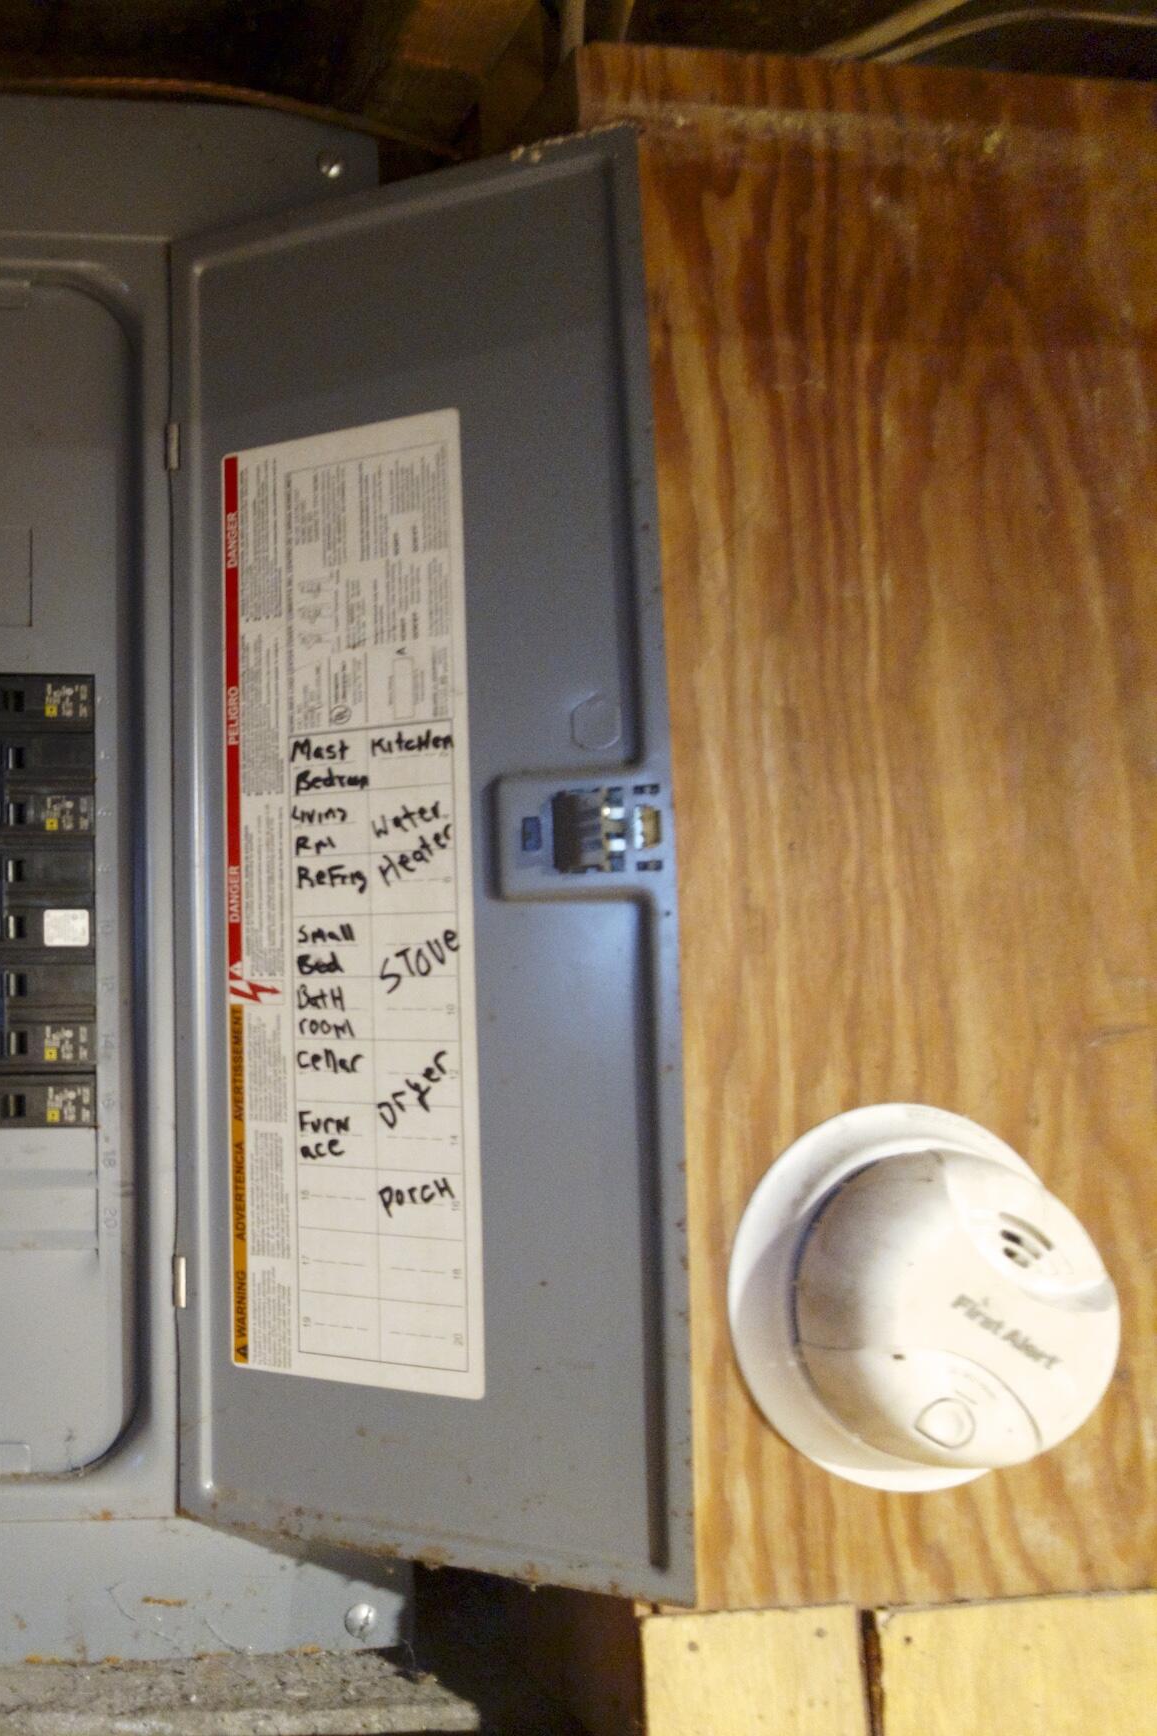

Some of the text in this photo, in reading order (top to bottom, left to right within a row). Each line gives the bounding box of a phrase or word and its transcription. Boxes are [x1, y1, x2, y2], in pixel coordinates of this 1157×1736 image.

[226, 511, 239, 568] DANGER
[228, 686, 240, 746] PELIGRO
[371, 801, 440, 838] Water
[378, 823, 452, 887] Heater
[229, 865, 241, 923] DANGER
[231, 1006, 244, 1123] AVERTISSEMENT
[233, 1142, 246, 1242] ADVERTENCIA
[234, 1270, 247, 1337] WARNING
[951, 1293, 1063, 1370] First Alert
